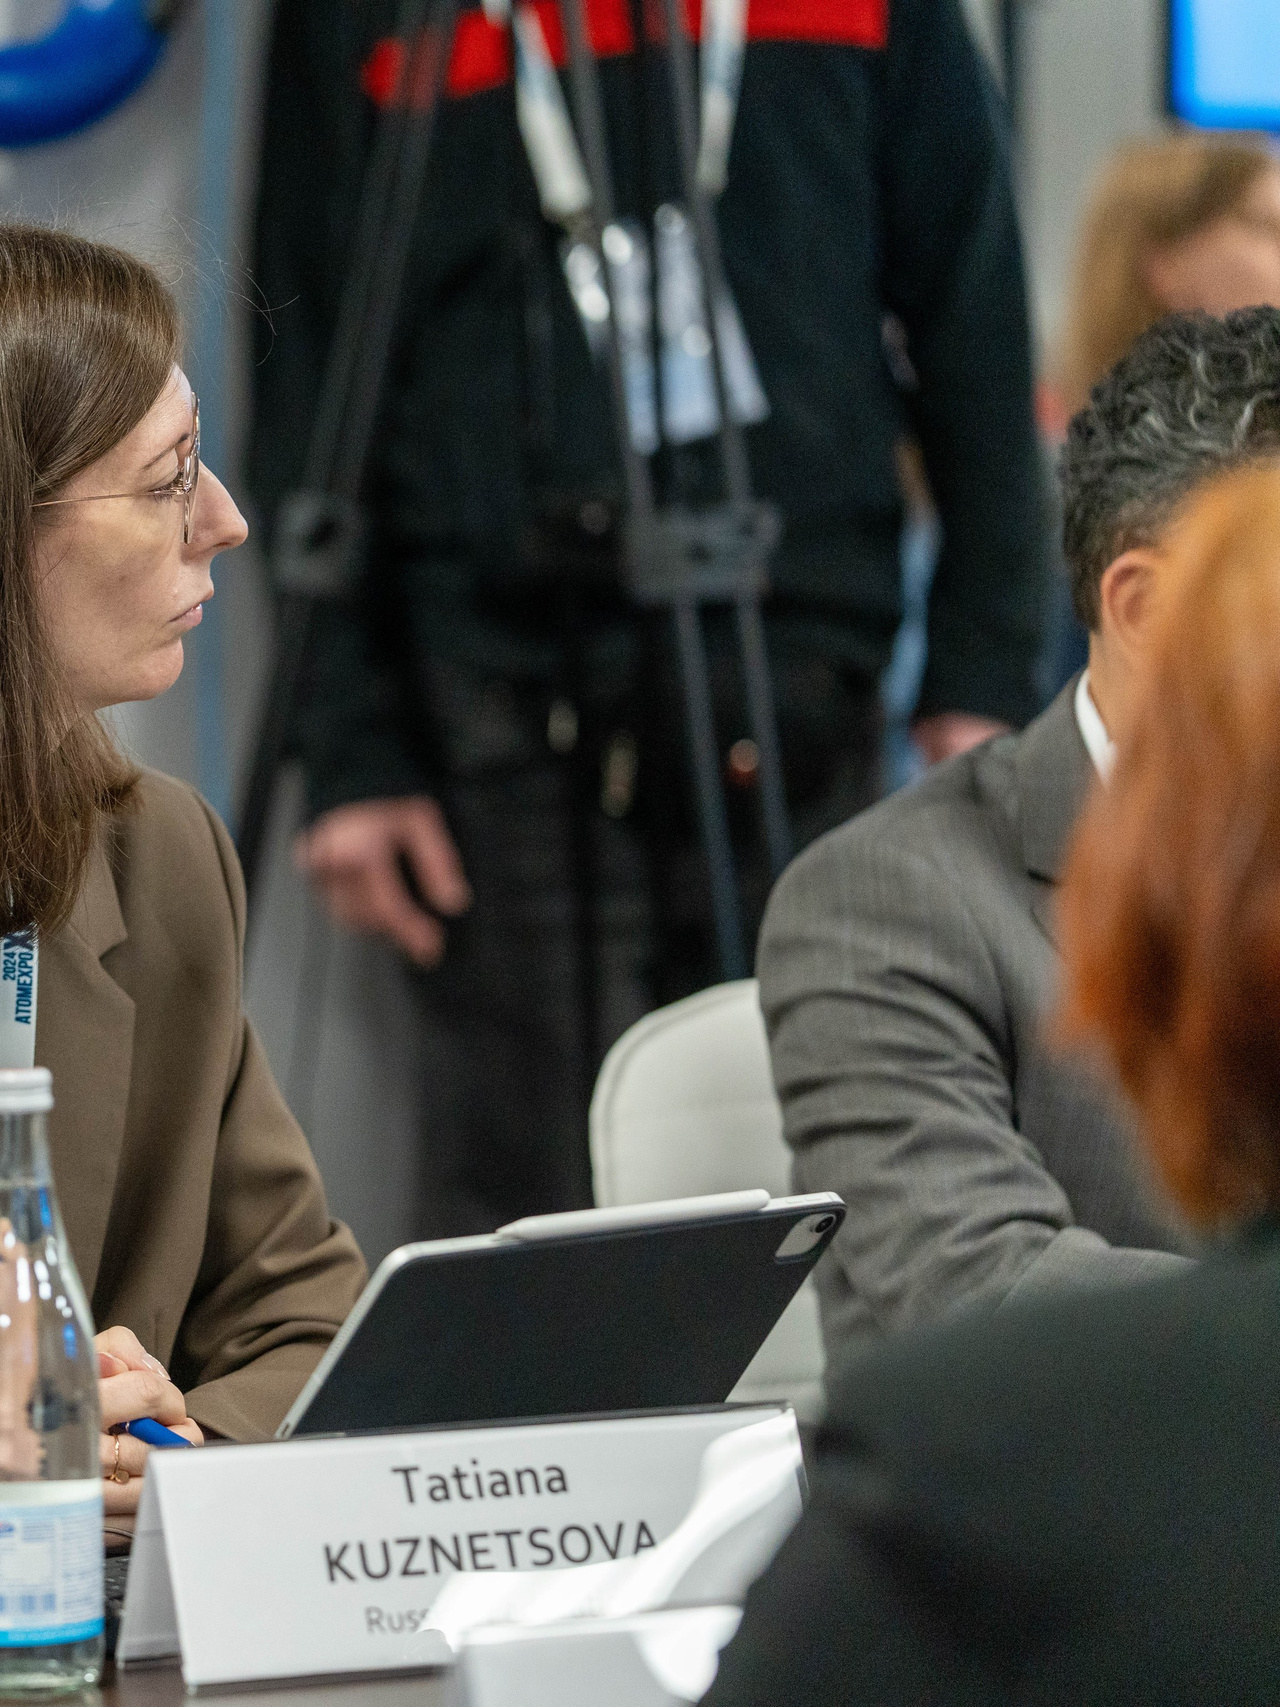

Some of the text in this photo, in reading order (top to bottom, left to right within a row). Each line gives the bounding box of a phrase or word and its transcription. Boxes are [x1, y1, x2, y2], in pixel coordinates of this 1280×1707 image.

[3, 951, 17, 980] 2024
[15, 952, 34, 1025] ATOMEXPO
[392, 1459, 568, 1503] Tatiana
[323, 1518, 658, 1583] KUZNETSOVA
